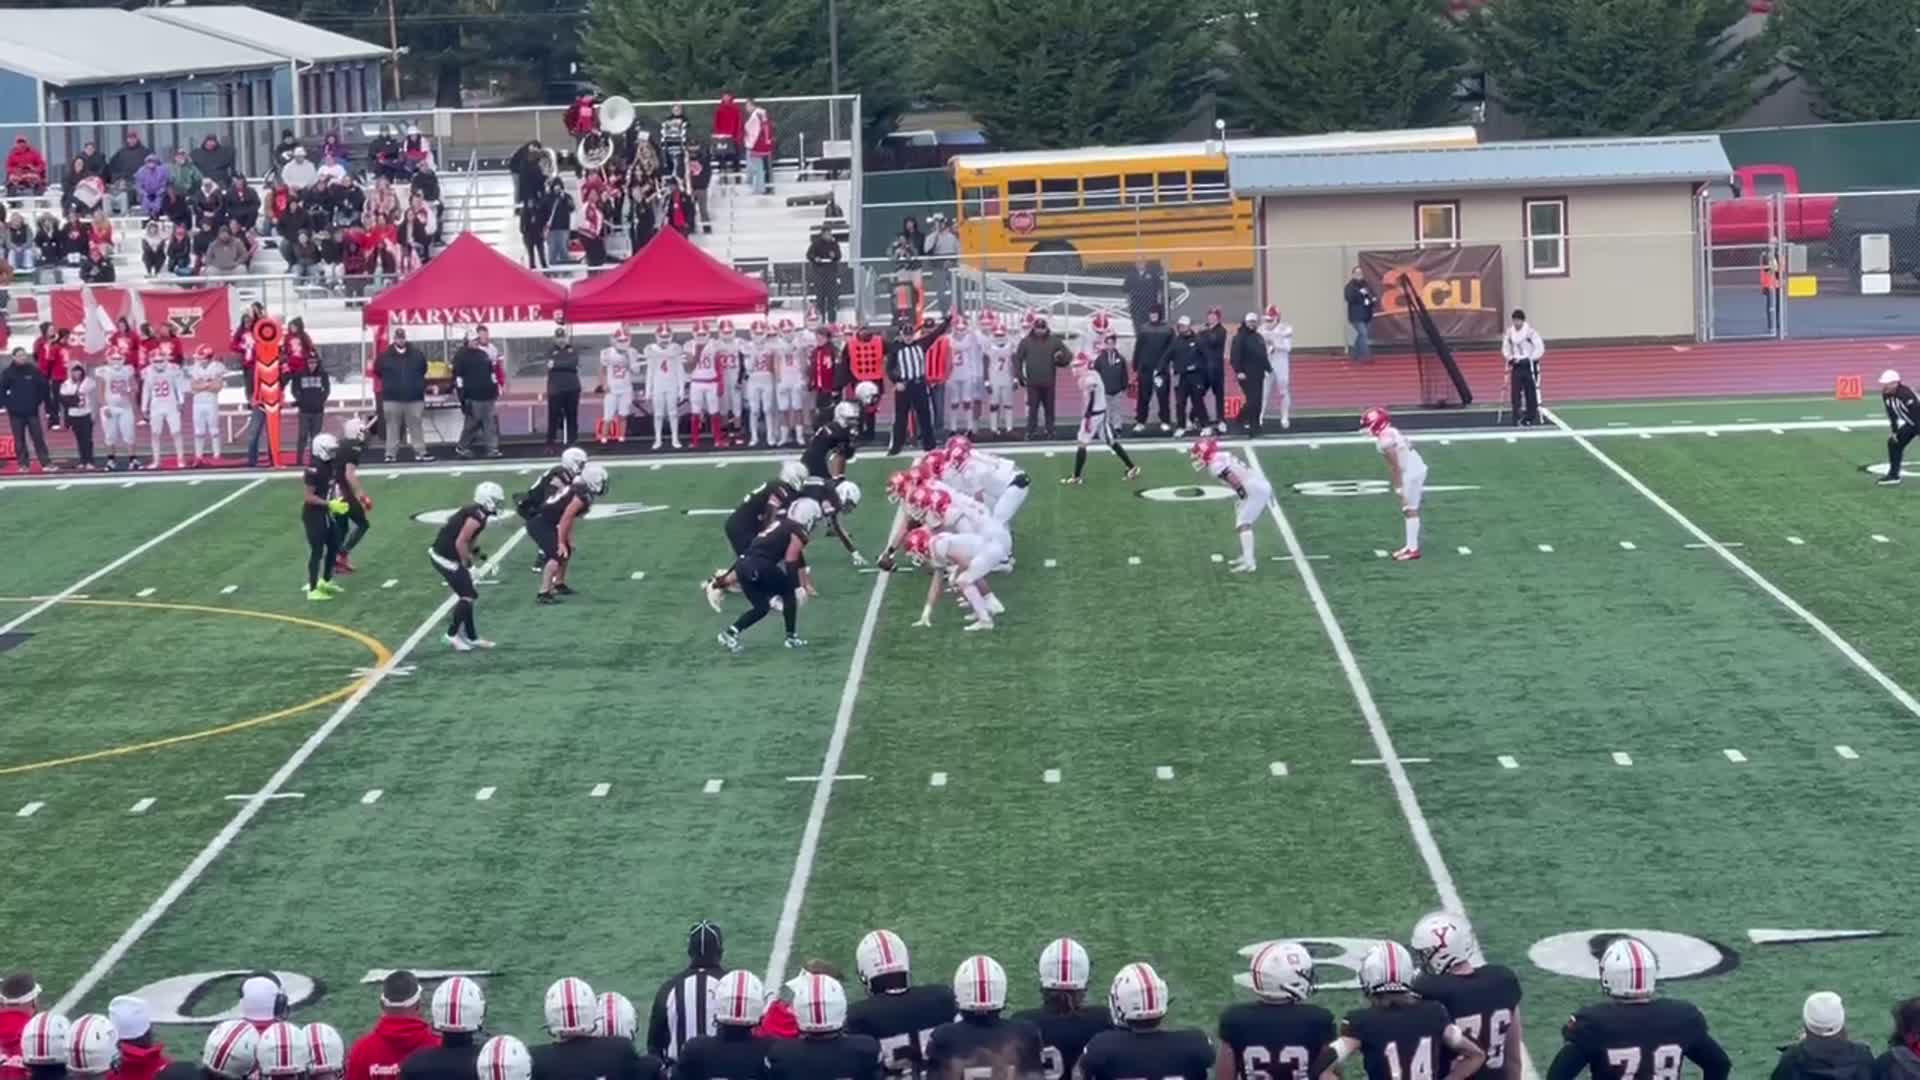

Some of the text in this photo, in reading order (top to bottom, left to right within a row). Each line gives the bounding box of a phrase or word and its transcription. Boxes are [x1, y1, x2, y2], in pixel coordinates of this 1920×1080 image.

[388, 304, 543, 325] MARYSVILLE
[659, 359, 668, 374] 4
[1839, 378, 1859, 396] 20
[1431, 926, 1451, 949] Y
[1242, 1045, 1311, 1080] 63
[1384, 1036, 1433, 1080] 14
[1606, 1043, 1683, 1080] 78
